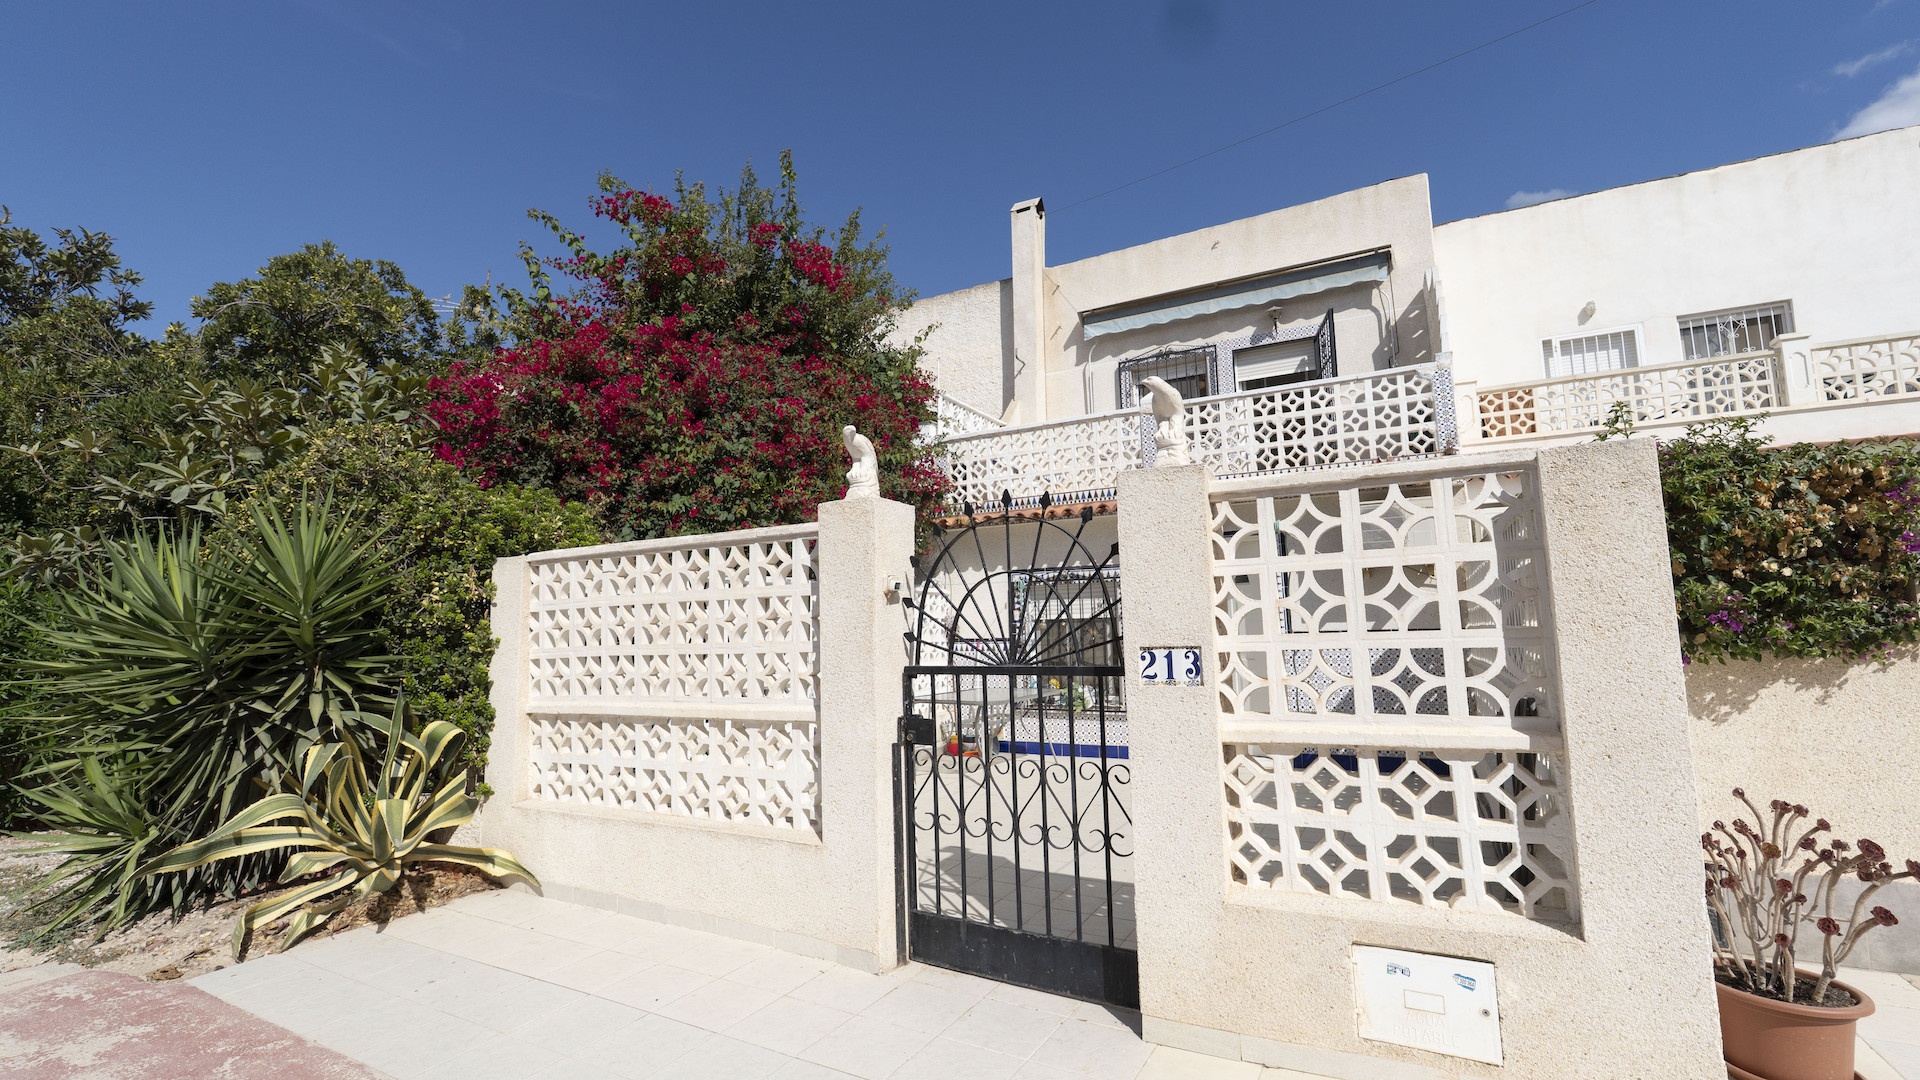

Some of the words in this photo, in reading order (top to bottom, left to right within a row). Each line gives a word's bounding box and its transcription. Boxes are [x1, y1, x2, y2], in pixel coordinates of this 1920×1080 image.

[1140, 650, 1201, 680] 213
[1405, 1012, 1446, 1026] AGUA
[1393, 1023, 1459, 1048] POTABLE
